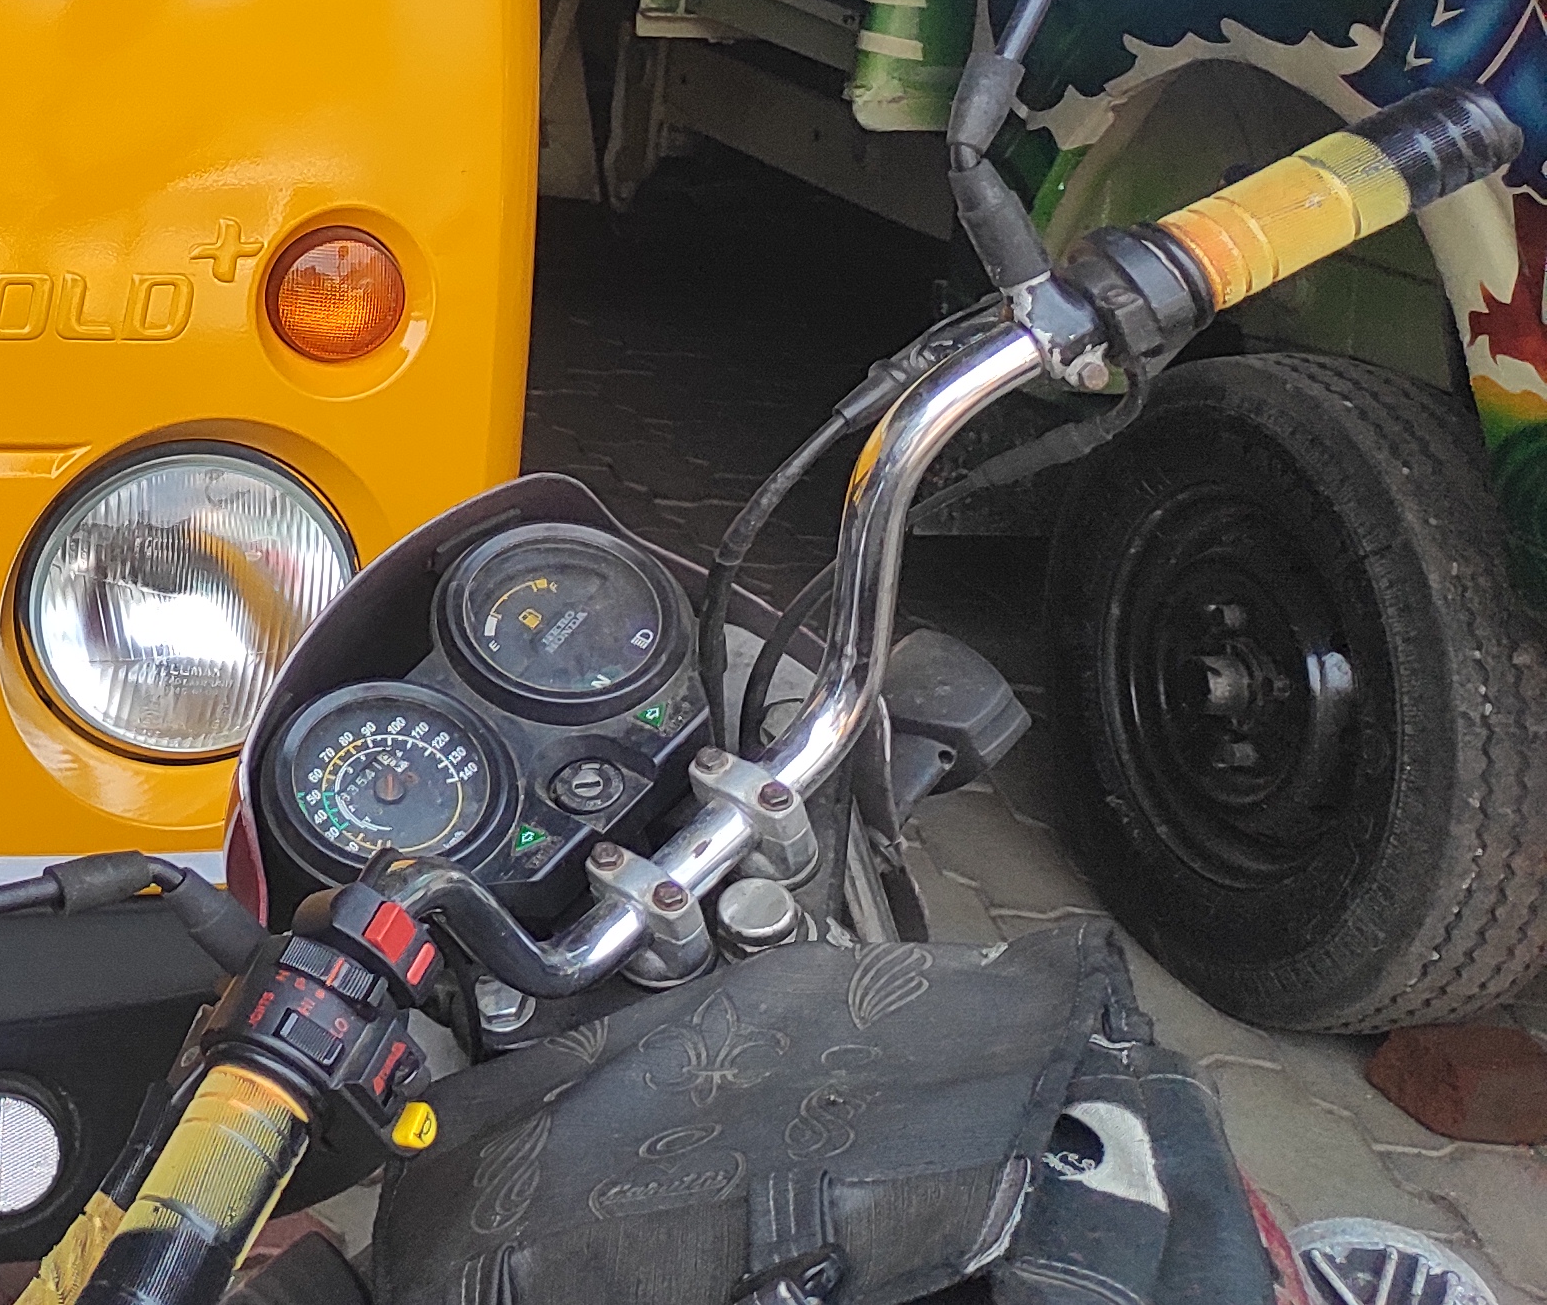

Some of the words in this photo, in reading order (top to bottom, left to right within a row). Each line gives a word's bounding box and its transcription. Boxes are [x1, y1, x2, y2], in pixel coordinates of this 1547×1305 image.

[544, 611, 589, 655] HONDA
[360, 721, 377, 736] 90
[387, 716, 407, 735] 100
[411, 721, 430, 738] 110
[338, 731, 354, 746] 80
[432, 731, 450, 749] 120
[318, 747, 335, 763] 70
[448, 746, 467, 765] 130
[307, 768, 323, 783] 60
[459, 761, 479, 781] 140
[306, 789, 322, 805] 50
[313, 809, 328, 825] 40
